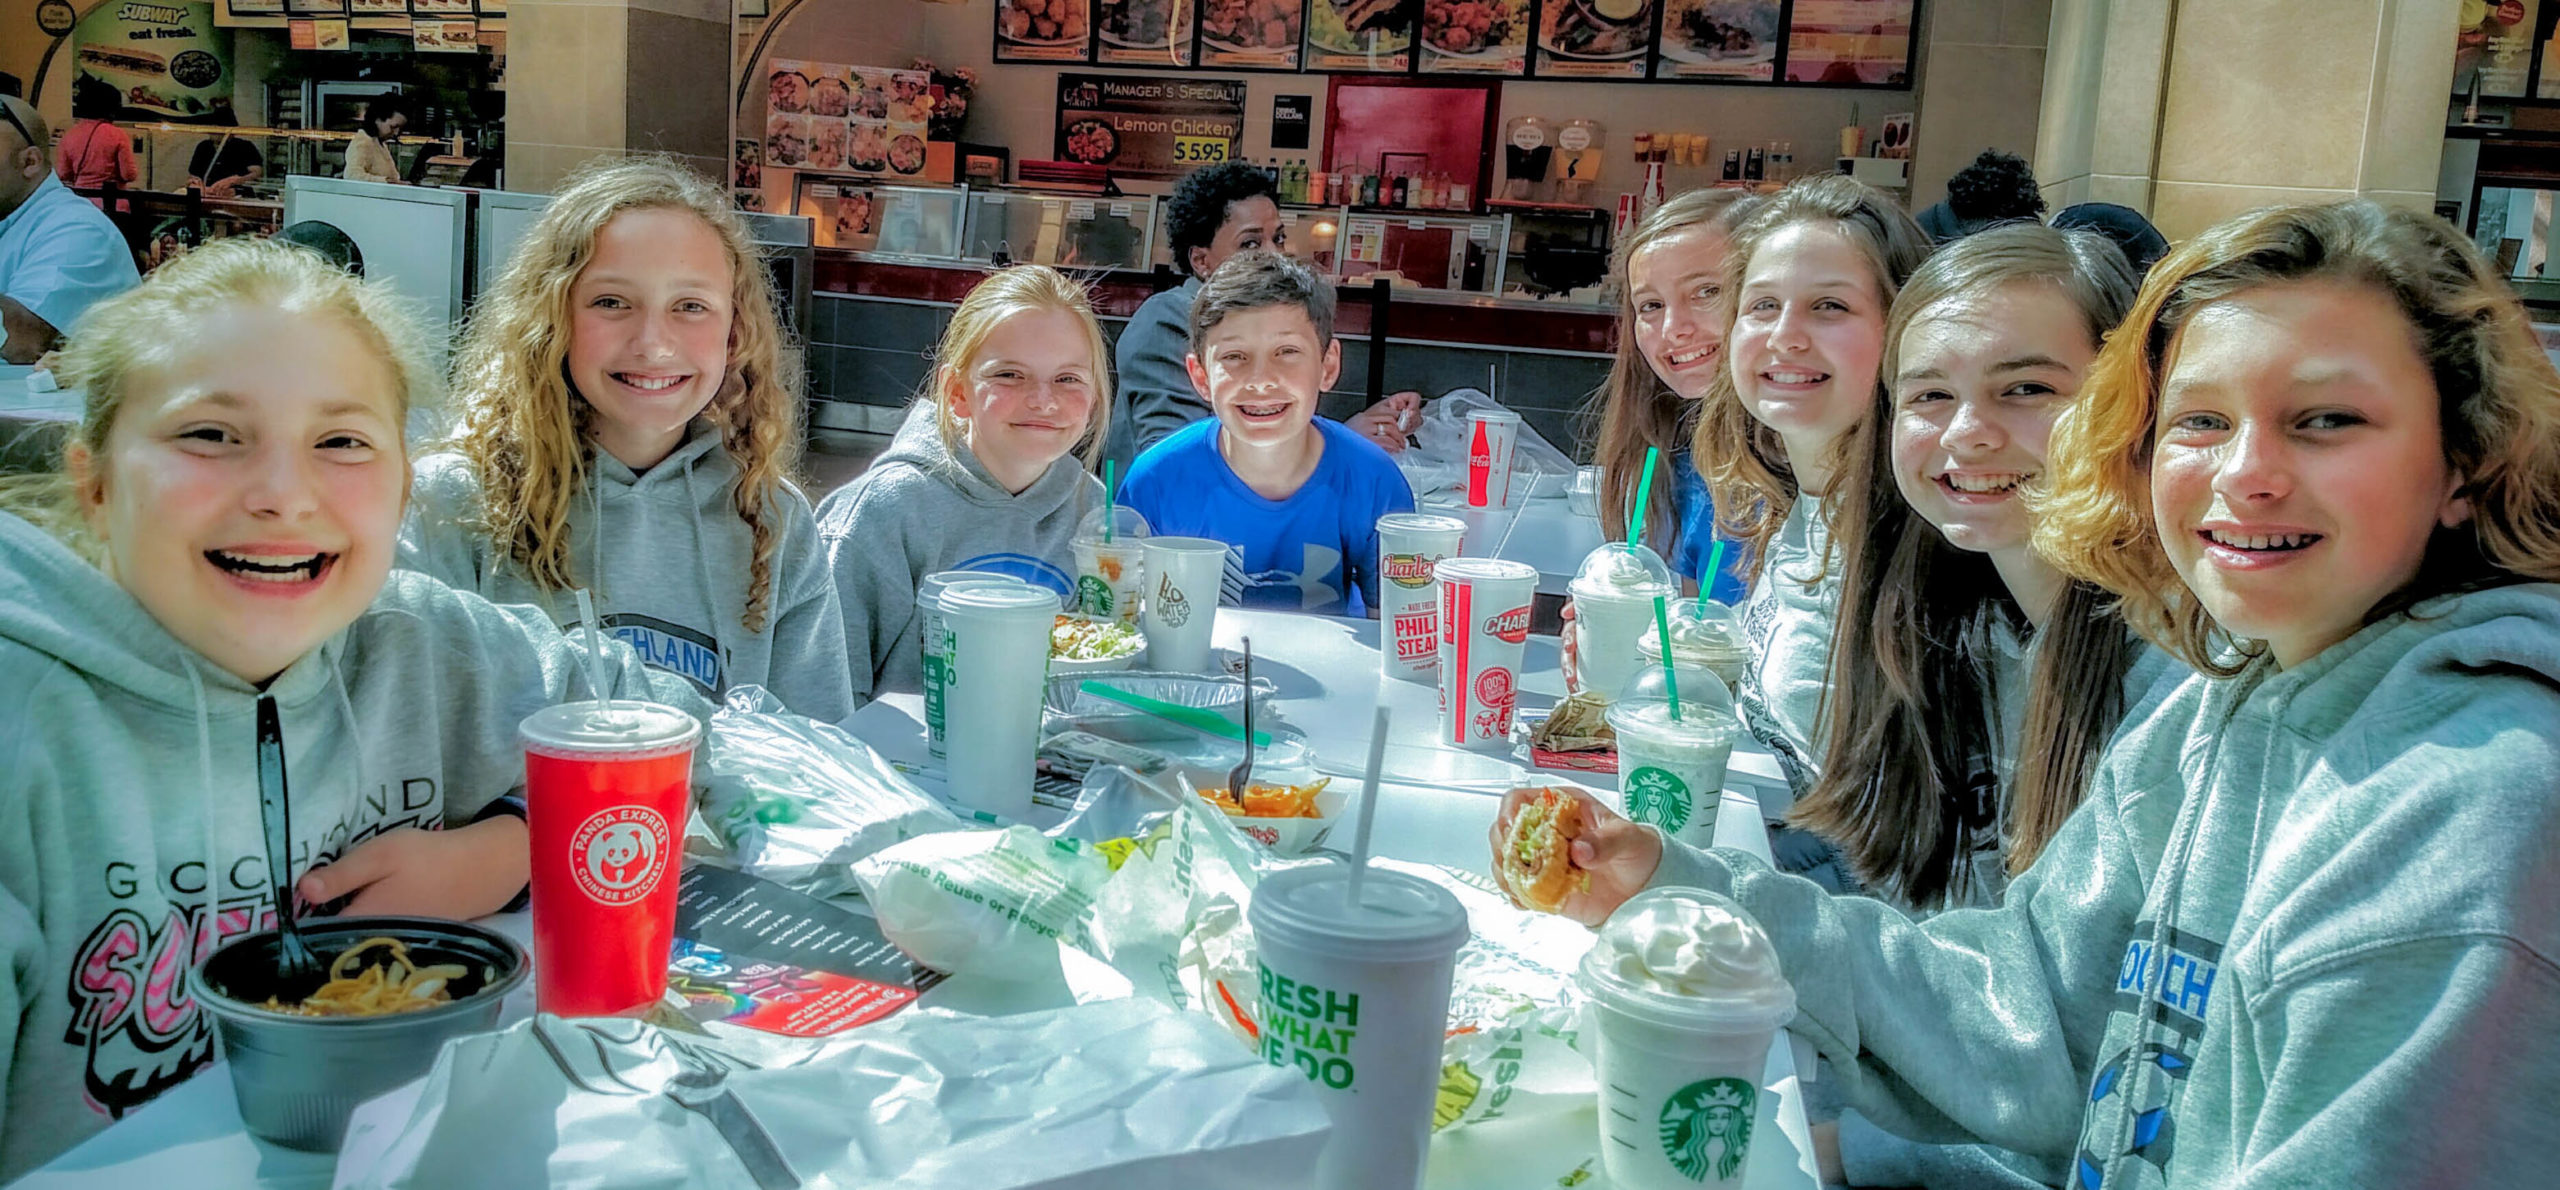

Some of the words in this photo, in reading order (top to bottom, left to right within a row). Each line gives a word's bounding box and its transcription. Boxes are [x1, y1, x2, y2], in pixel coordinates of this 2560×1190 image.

[118, 3, 188, 25] SUBWAY
[129, 28, 153, 40] eat
[1104, 82, 1174, 98] MANAGER'S
[1114, 116, 1167, 132] Lemon
[1171, 119, 1233, 136] Chicken
[1157, 600, 1190, 617] WATER
[575, 813, 616, 851] PANDA
[620, 810, 666, 845] EXPRESS
[578, 867, 619, 900] CHINESE
[624, 861, 662, 899] KITCHEN
[933, 870, 984, 904] Reuse
[989, 898, 1006, 914] or
[1007, 908, 1061, 939] Recyc
[1257, 956, 1359, 1027] RESH
[1266, 1004, 1356, 1055] WHAT
